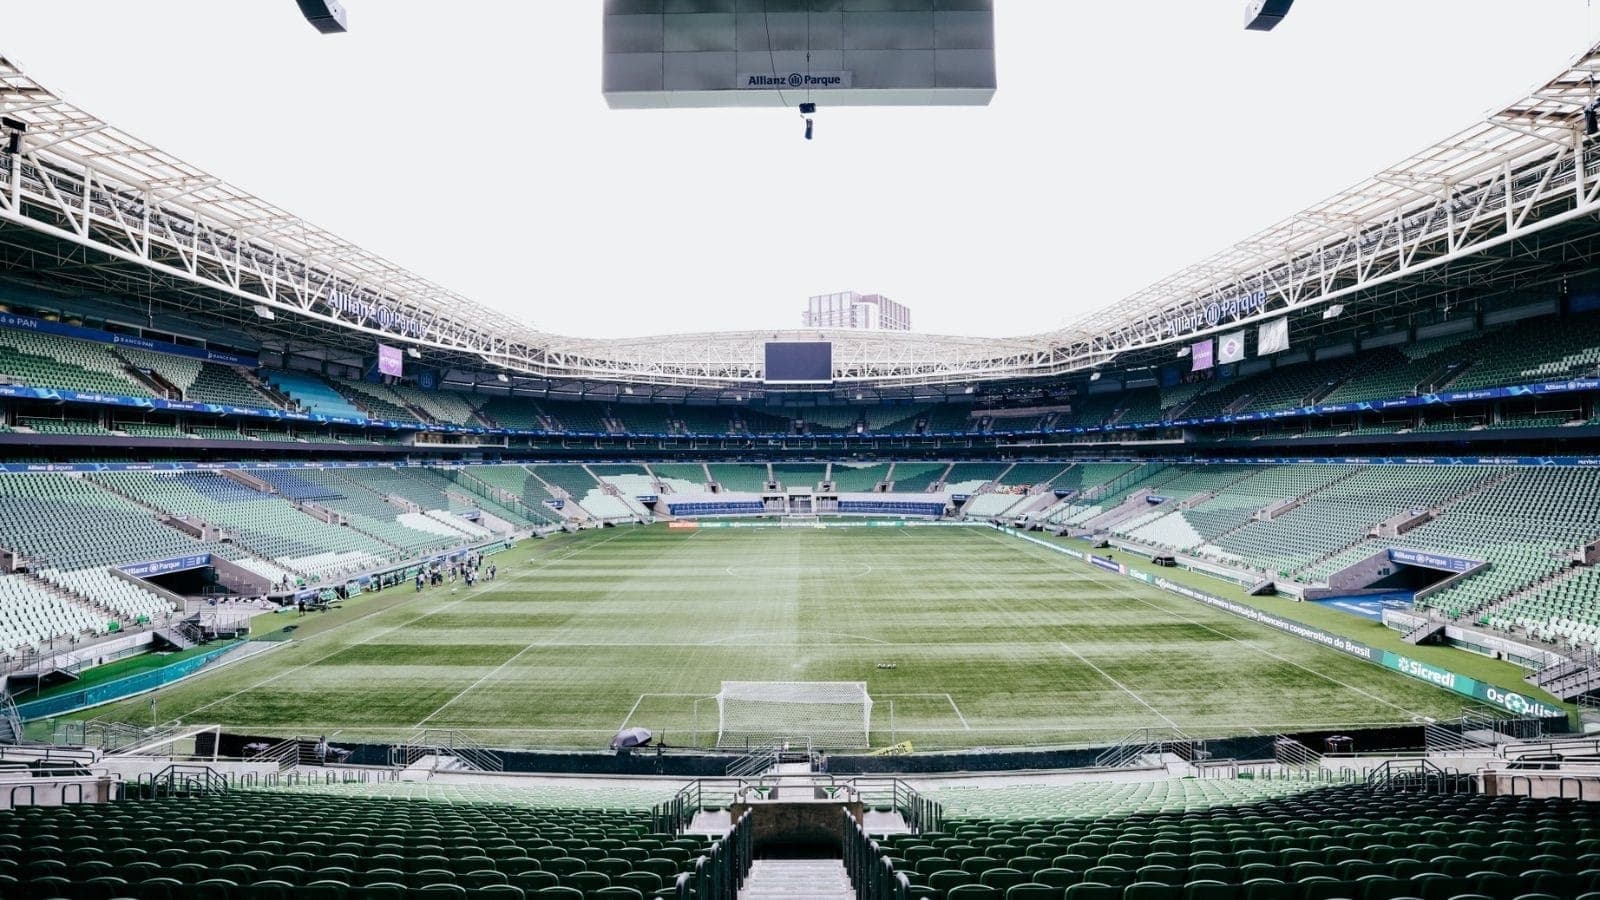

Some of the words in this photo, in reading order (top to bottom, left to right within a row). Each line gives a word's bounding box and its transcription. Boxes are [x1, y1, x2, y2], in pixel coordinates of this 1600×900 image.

[748, 75, 786, 86] Allianz
[804, 75, 841, 87] Parque
[327, 288, 377, 320] Allianz
[391, 311, 428, 338] Parque
[1167, 312, 1203, 336] Allianz
[1222, 291, 1267, 317] Parque
[17, 317, 37, 329] PAN
[1544, 383, 1567, 391] Allianz
[1577, 381, 1599, 389] Parque
[1394, 551, 1415, 561] Allianz
[1425, 557, 1447, 567] Parque
[124, 566, 149, 576] Allianz
[159, 561, 180, 571] Parque
[1289, 625, 1333, 645] cooperativa
[1334, 639, 1345, 649] do
[1345, 642, 1371, 658] Brasil
[1409, 662, 1455, 687] Sicredi
[1487, 689, 1504, 703] Os
